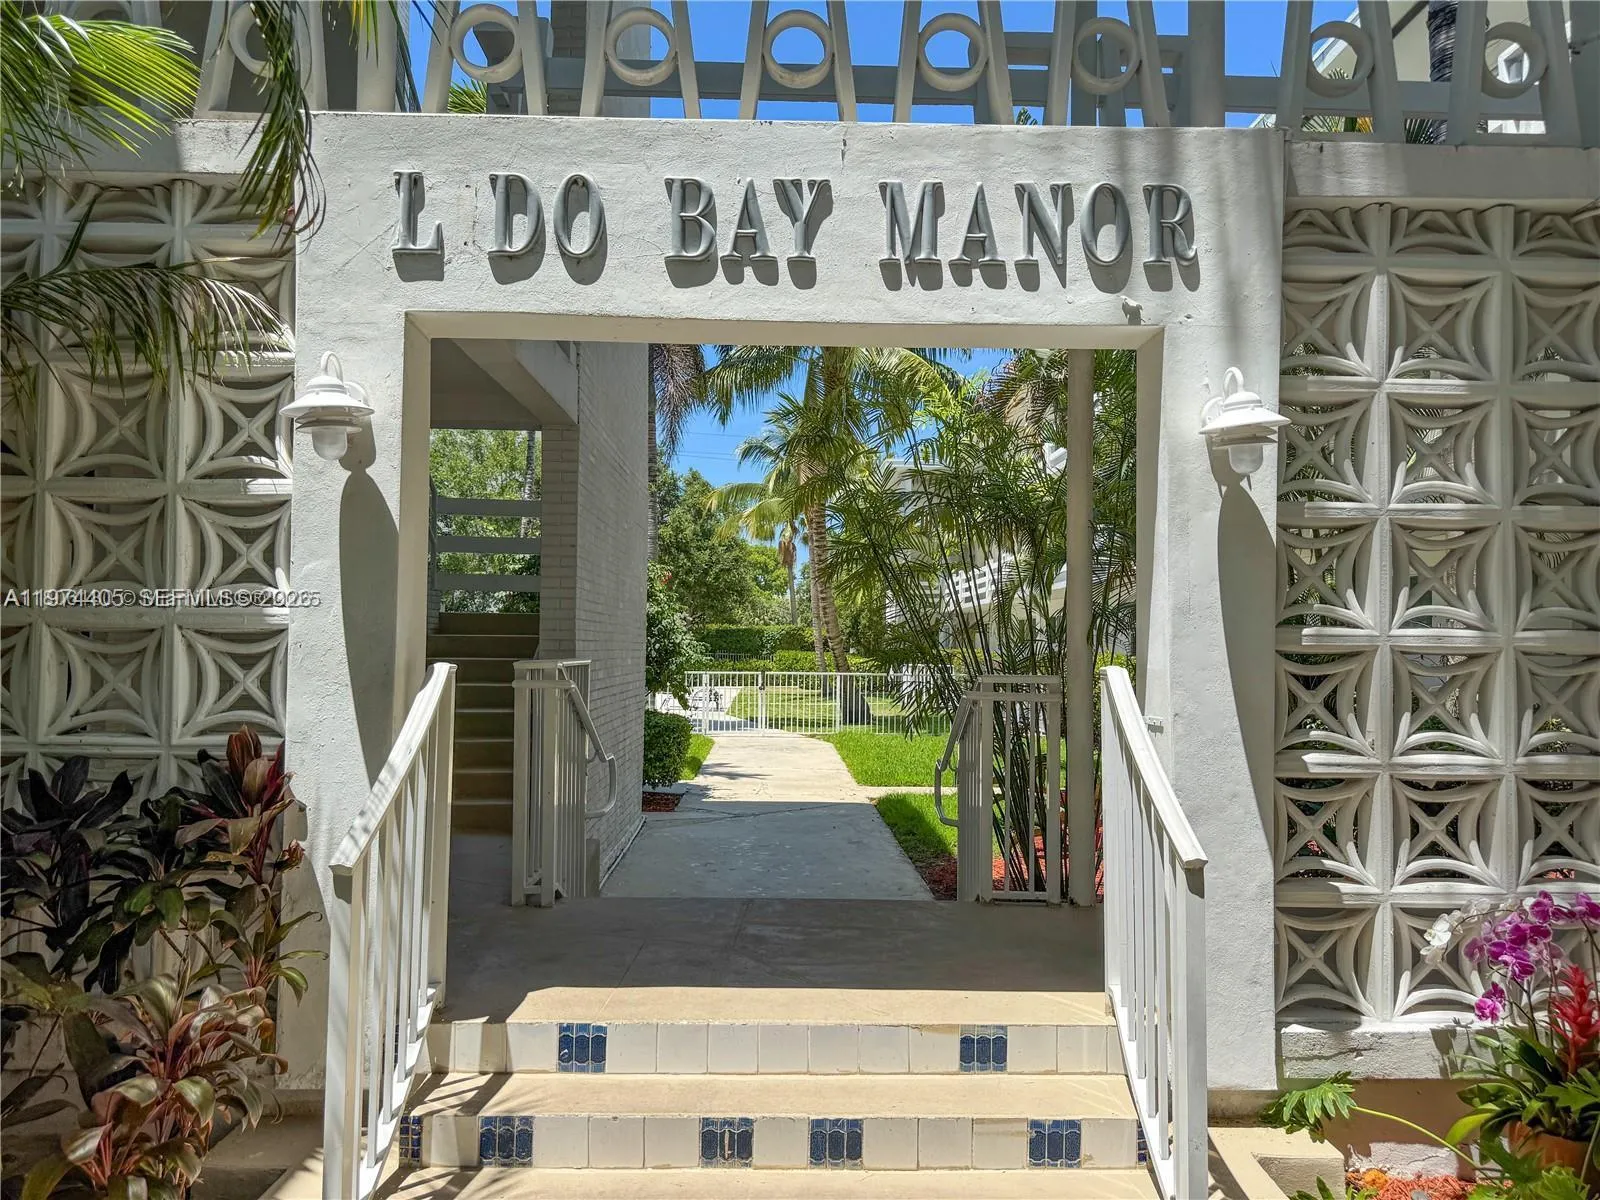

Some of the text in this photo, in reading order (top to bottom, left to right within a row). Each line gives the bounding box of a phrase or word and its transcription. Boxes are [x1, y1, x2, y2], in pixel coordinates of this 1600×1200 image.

[392, 170, 1198, 267] L DO BAY MANOR
